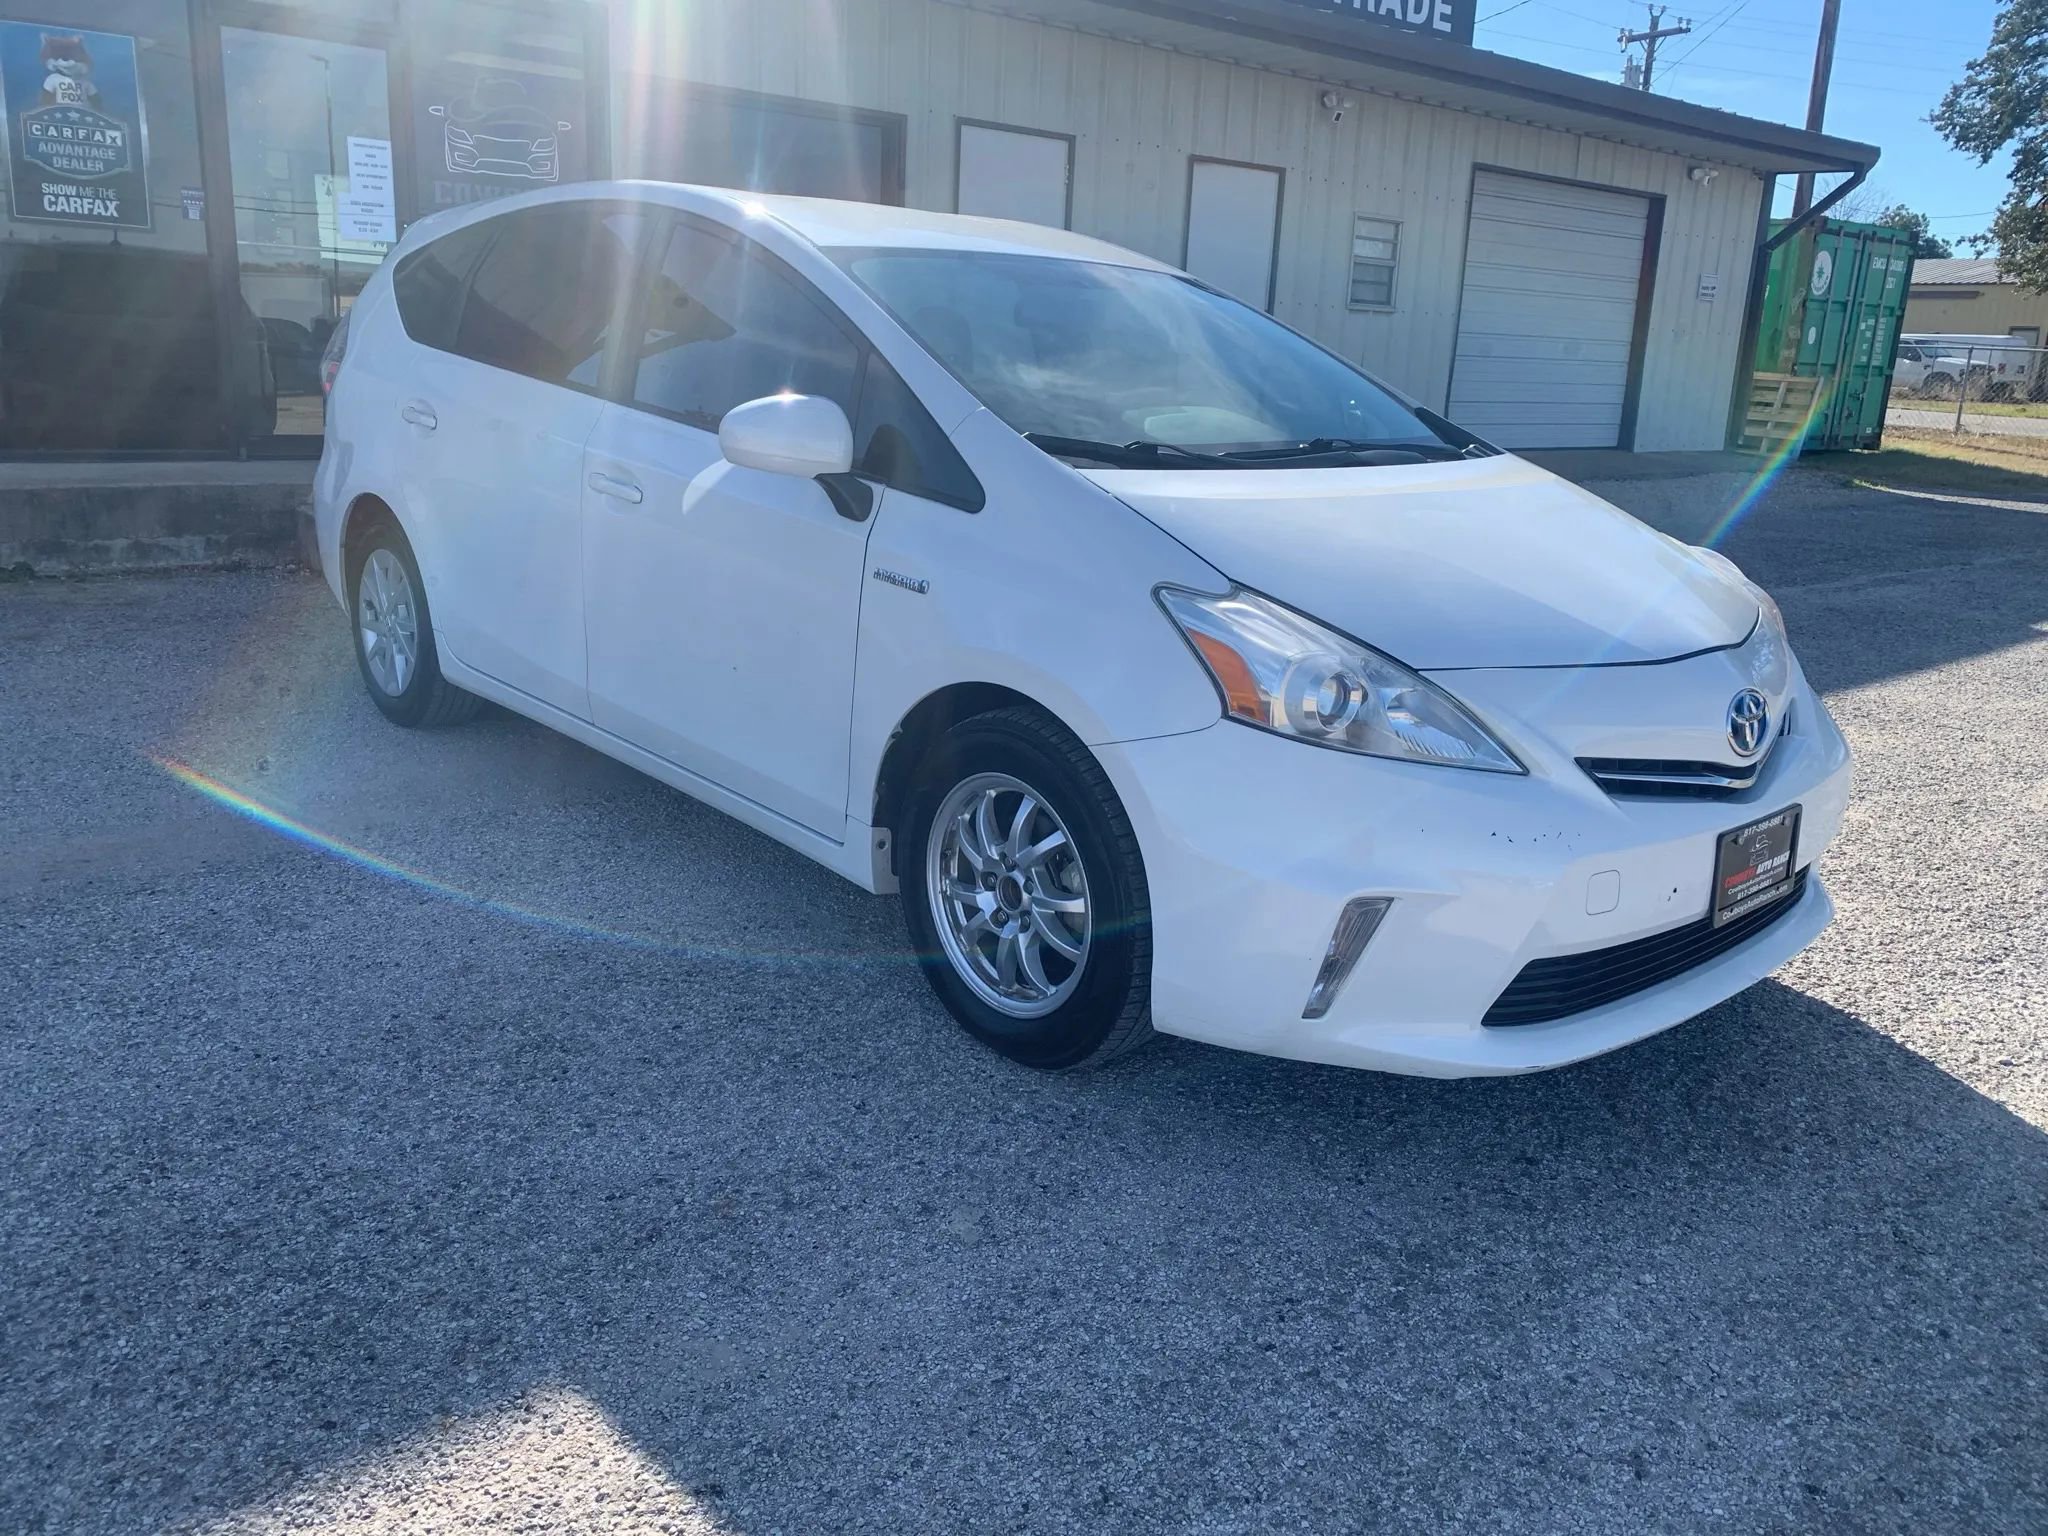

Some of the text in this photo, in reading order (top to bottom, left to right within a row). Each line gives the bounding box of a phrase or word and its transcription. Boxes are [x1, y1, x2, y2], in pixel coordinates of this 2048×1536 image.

[1334, 0, 1452, 33] ADE
[58, 81, 82, 93] CAR
[61, 92, 82, 103] FOX
[31, 123, 121, 146] CARFAX
[38, 141, 117, 160] ADVANTAGE
[52, 156, 104, 172] DEALER
[41, 182, 117, 200] SHOW ME THE
[43, 194, 120, 218] CARFAX
